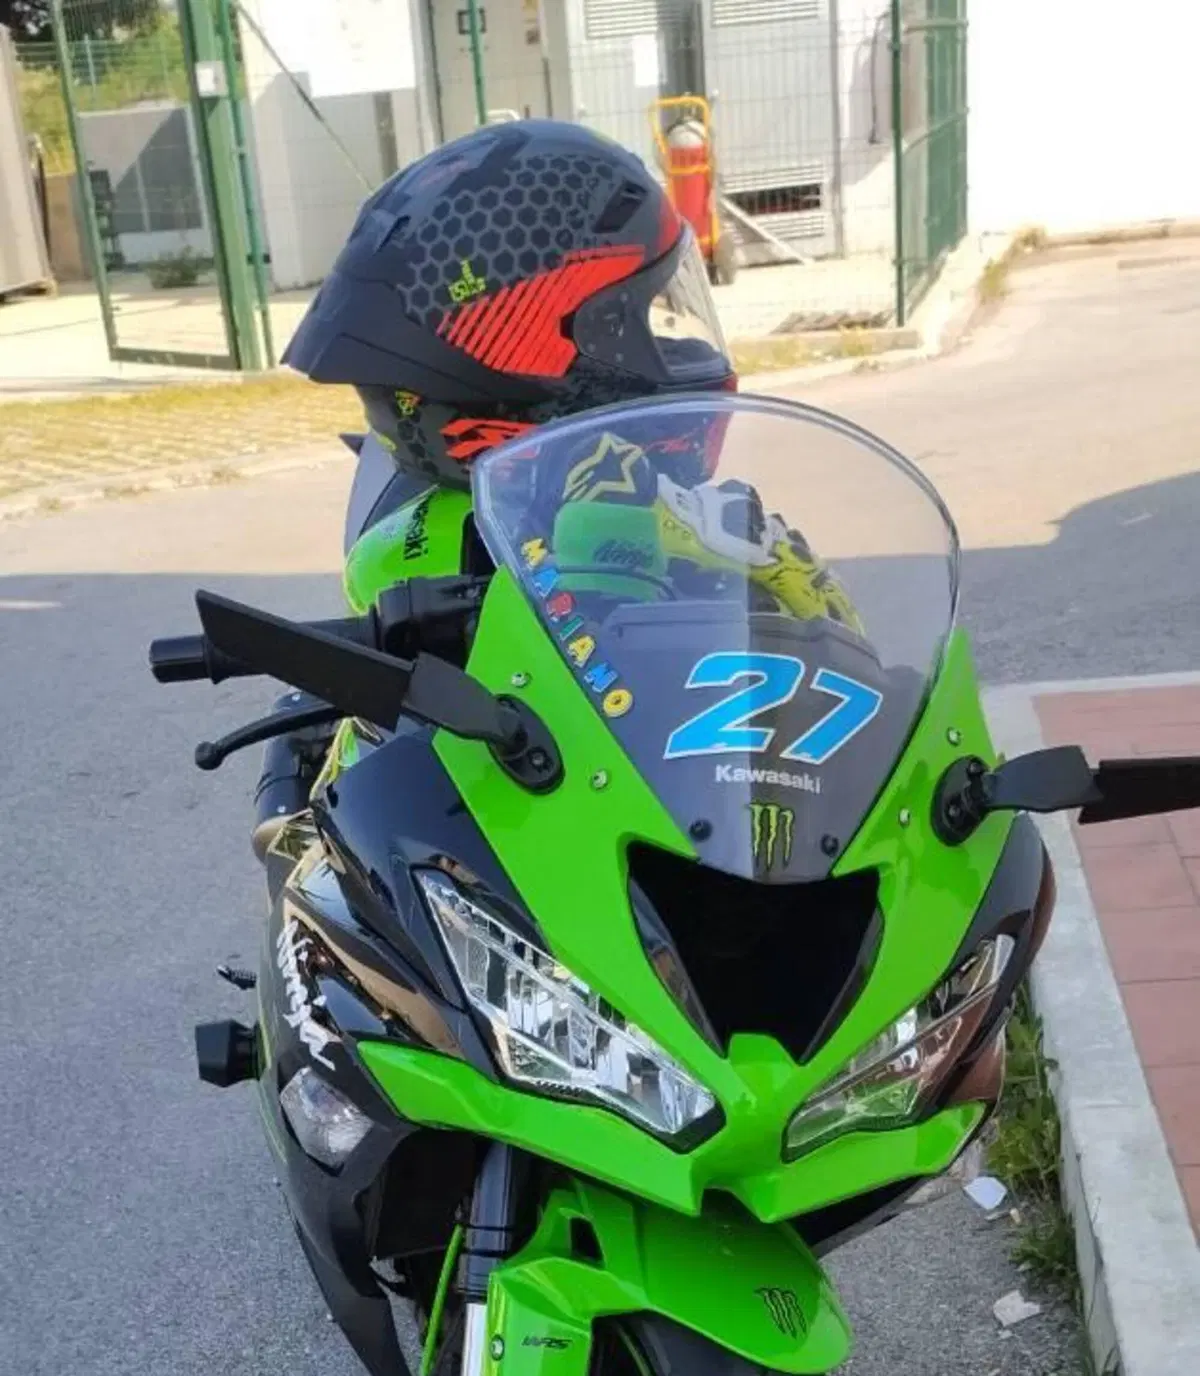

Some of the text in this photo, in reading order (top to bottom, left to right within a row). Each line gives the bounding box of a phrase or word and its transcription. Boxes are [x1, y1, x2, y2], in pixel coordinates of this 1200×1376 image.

[520, 538, 634, 718] MARIANO
[663, 651, 883, 764] 27
[715, 763, 822, 794] Kawasaki
